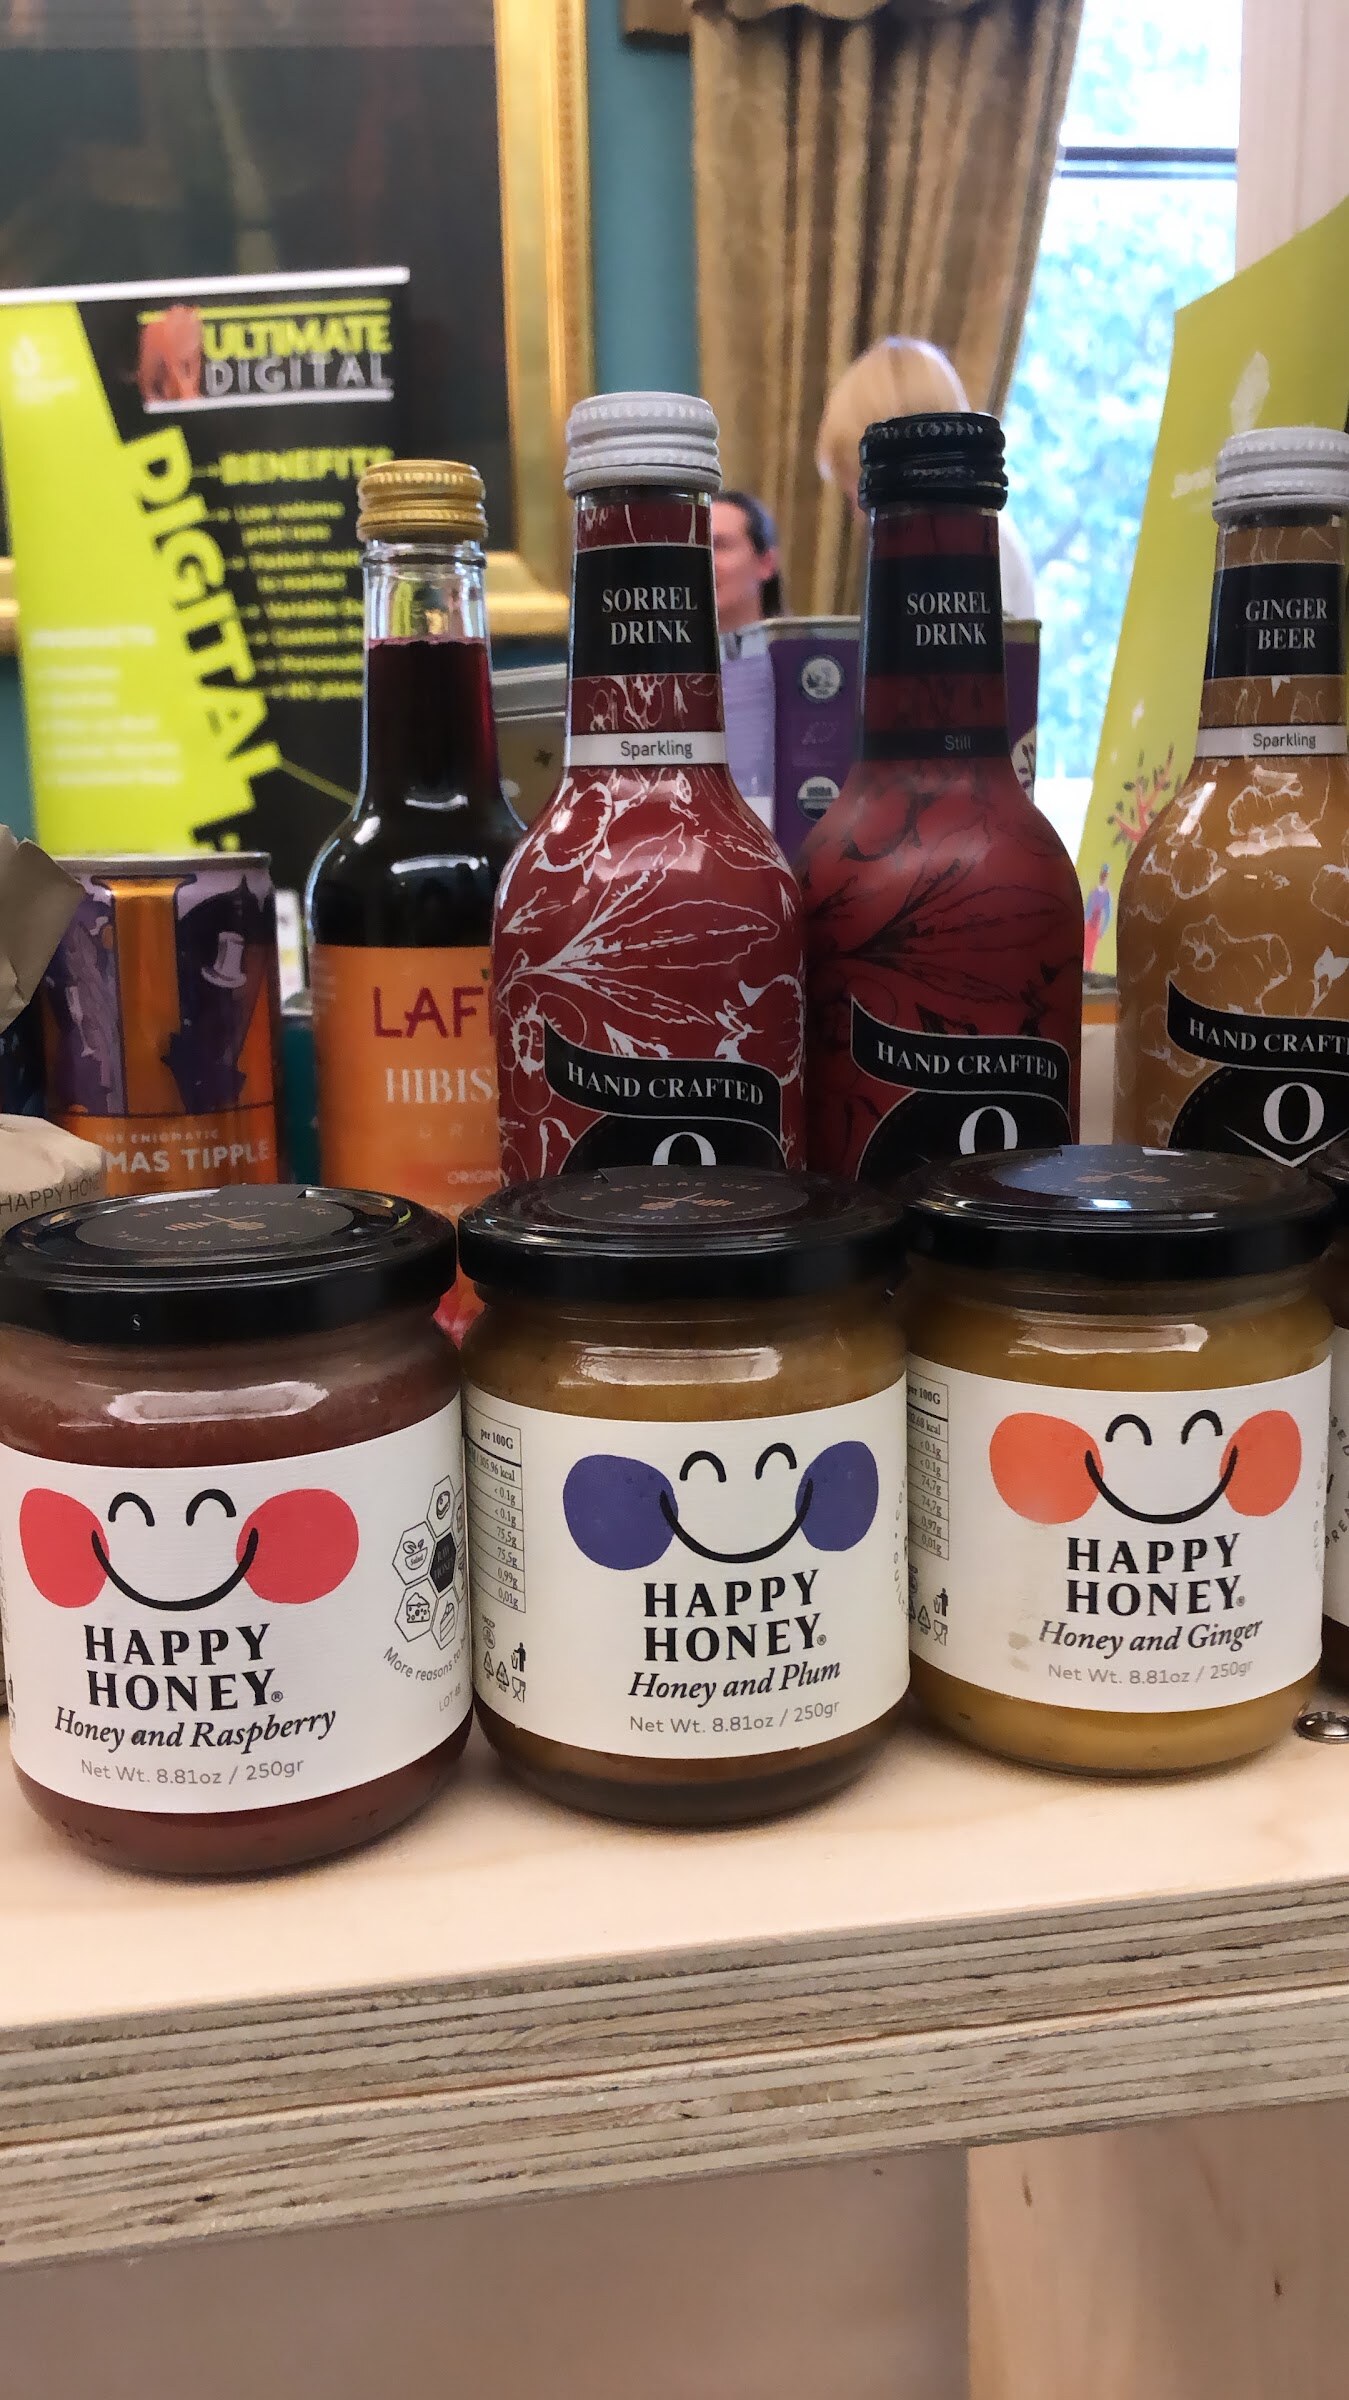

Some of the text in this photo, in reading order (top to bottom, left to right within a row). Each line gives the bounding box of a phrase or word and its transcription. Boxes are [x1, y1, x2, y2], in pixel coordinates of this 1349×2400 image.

[204, 315, 391, 360] ULTIMATE
[205, 352, 395, 396] DIGITAL
[602, 586, 698, 613] SORREL
[906, 591, 991, 616] SORREL
[1245, 597, 1328, 622] GINGER
[610, 619, 692, 646] DRINK
[915, 622, 988, 647] DRINK
[1257, 627, 1317, 650] BEER
[620, 739, 693, 760] Sparkling
[944, 734, 972, 752] Still
[1252, 732, 1317, 751] Sparkling
[1189, 1017, 1257, 1052] HAND
[876, 1040, 1058, 1081] HAND CRAFTED
[567, 1061, 764, 1106] HAND CRAFTED
[181, 1138, 270, 1172] TIPPLE
[0, 1184, 64, 1215] HAPPY
[479, 1427, 515, 1450] per 100G
[500, 1465, 516, 1482] kcal
[1066, 1532, 1241, 1574] HAPPY
[643, 1569, 819, 1618] HAPPY
[83, 1623, 270, 1666] HAPPY
[1038, 1618, 1263, 1660] Honey and Ginger
[384, 1646, 414, 1680] More
[415, 1660, 453, 1681] reasons
[1048, 1664, 1082, 1681] Net
[1088, 1668, 1123, 1685] Wt.
[1129, 1669, 1190, 1685] 8.81oz
[1210, 1660, 1255, 1681] 250gr
[628, 1660, 841, 1708] Honey and Plum
[438, 1690, 454, 1712] LOT
[54, 1705, 337, 1755] Honey and Raspberry
[630, 1715, 664, 1733] Net
[670, 1717, 707, 1734] Wt.
[712, 1714, 774, 1733] 8.81oz
[794, 1701, 841, 1723] 250gr
[80, 1758, 111, 1780] Net
[115, 1763, 151, 1783] Wt.
[156, 1767, 222, 1785] 8.81oz
[246, 1758, 305, 1781] 250gr
